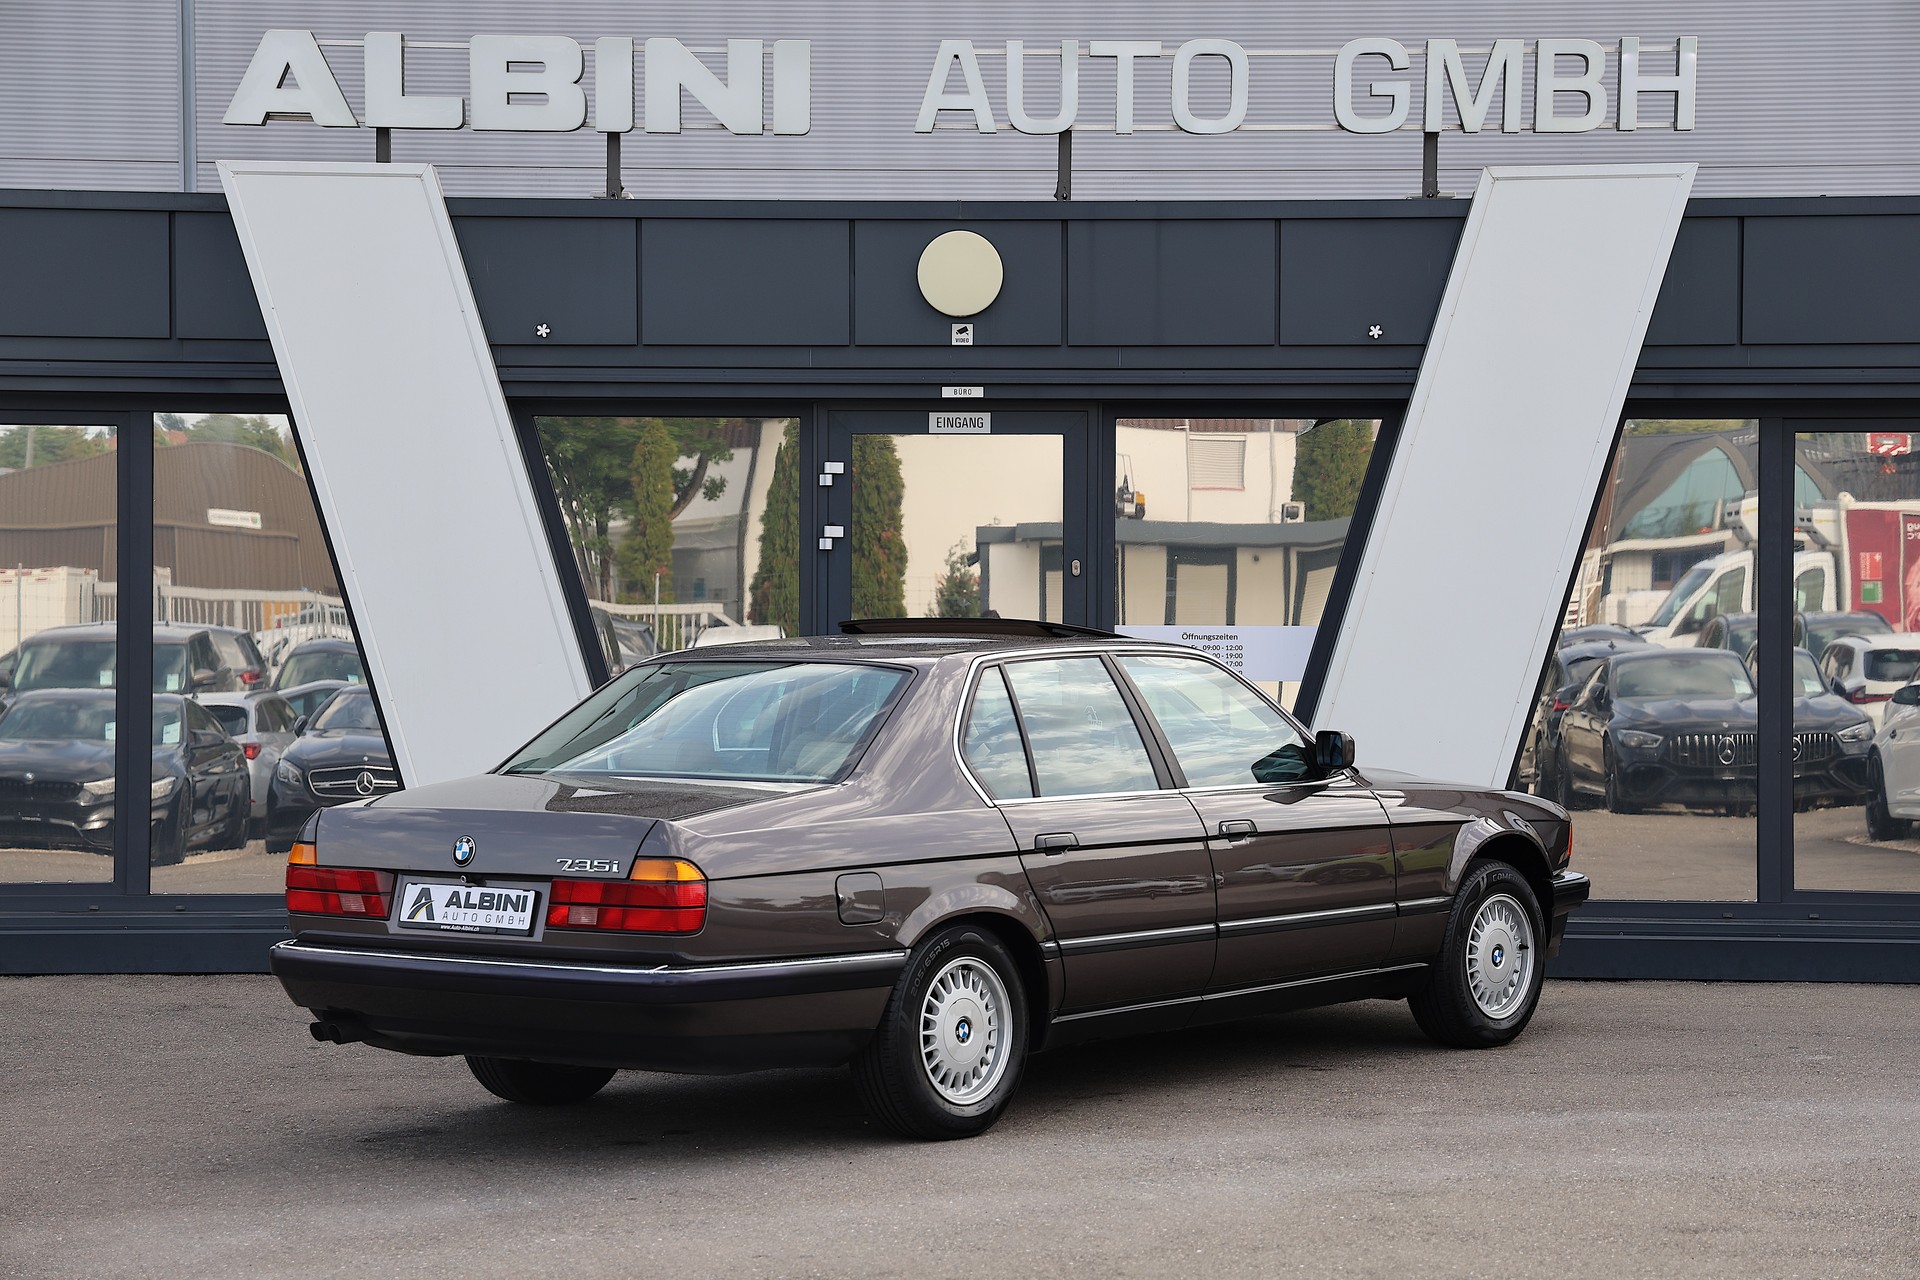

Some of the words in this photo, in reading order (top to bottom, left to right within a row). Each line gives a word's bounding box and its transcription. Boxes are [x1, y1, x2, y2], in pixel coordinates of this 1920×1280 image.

[222, 29, 812, 136] ALBINI
[915, 38, 1250, 134] AUTO
[1333, 35, 1699, 134] GMBH
[953, 388, 972, 396] BÜRO
[936, 417, 984, 429] EINGANG
[1181, 632, 1239, 641] Öffnungszeiten
[556, 858, 620, 873] 735i
[444, 890, 529, 913] ALBINI
[442, 911, 478, 923] AUTO
[484, 913, 526, 926] GMBH
